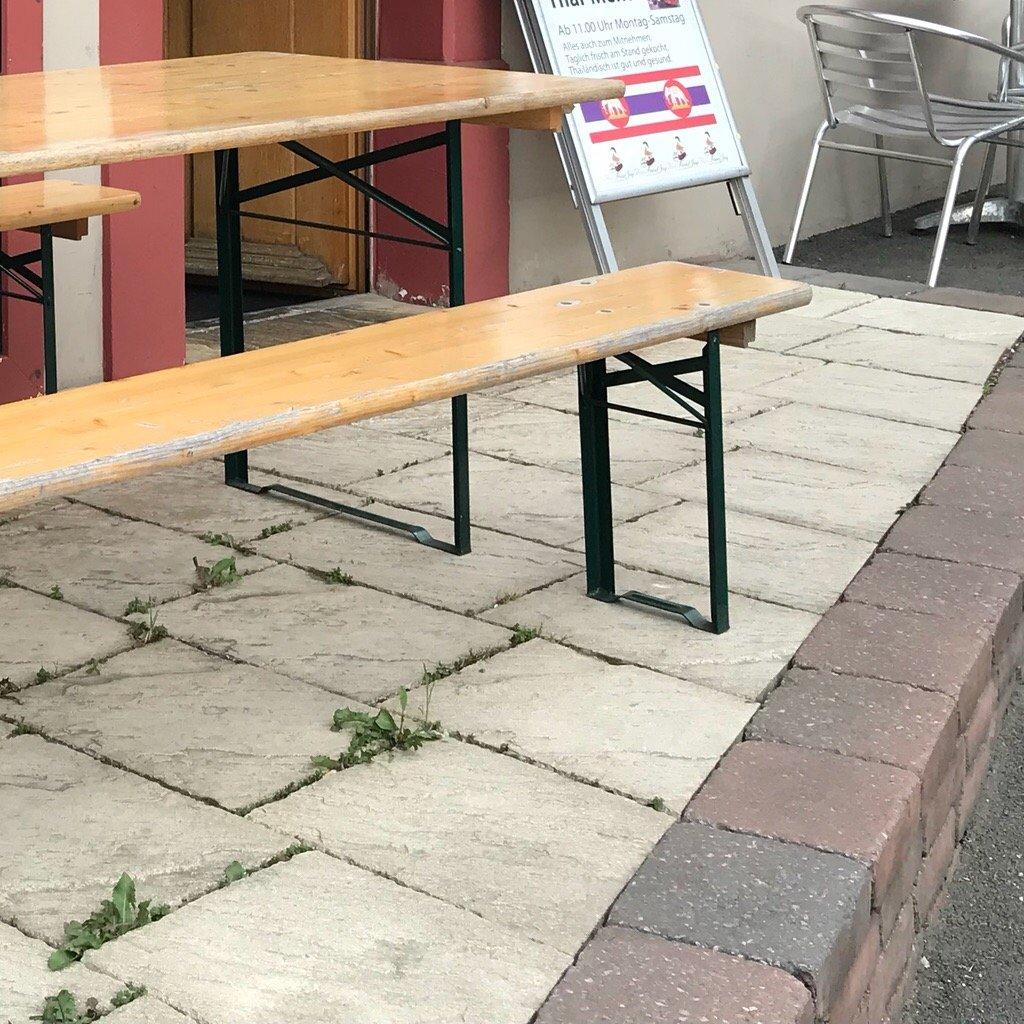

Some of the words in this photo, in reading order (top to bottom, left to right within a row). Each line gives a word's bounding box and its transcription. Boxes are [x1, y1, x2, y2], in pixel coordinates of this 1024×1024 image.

[558, 24, 571, 35] Ab
[573, 21, 596, 33] 11.00
[597, 19, 613, 31] Uhr
[598, 39, 612, 48] zum
